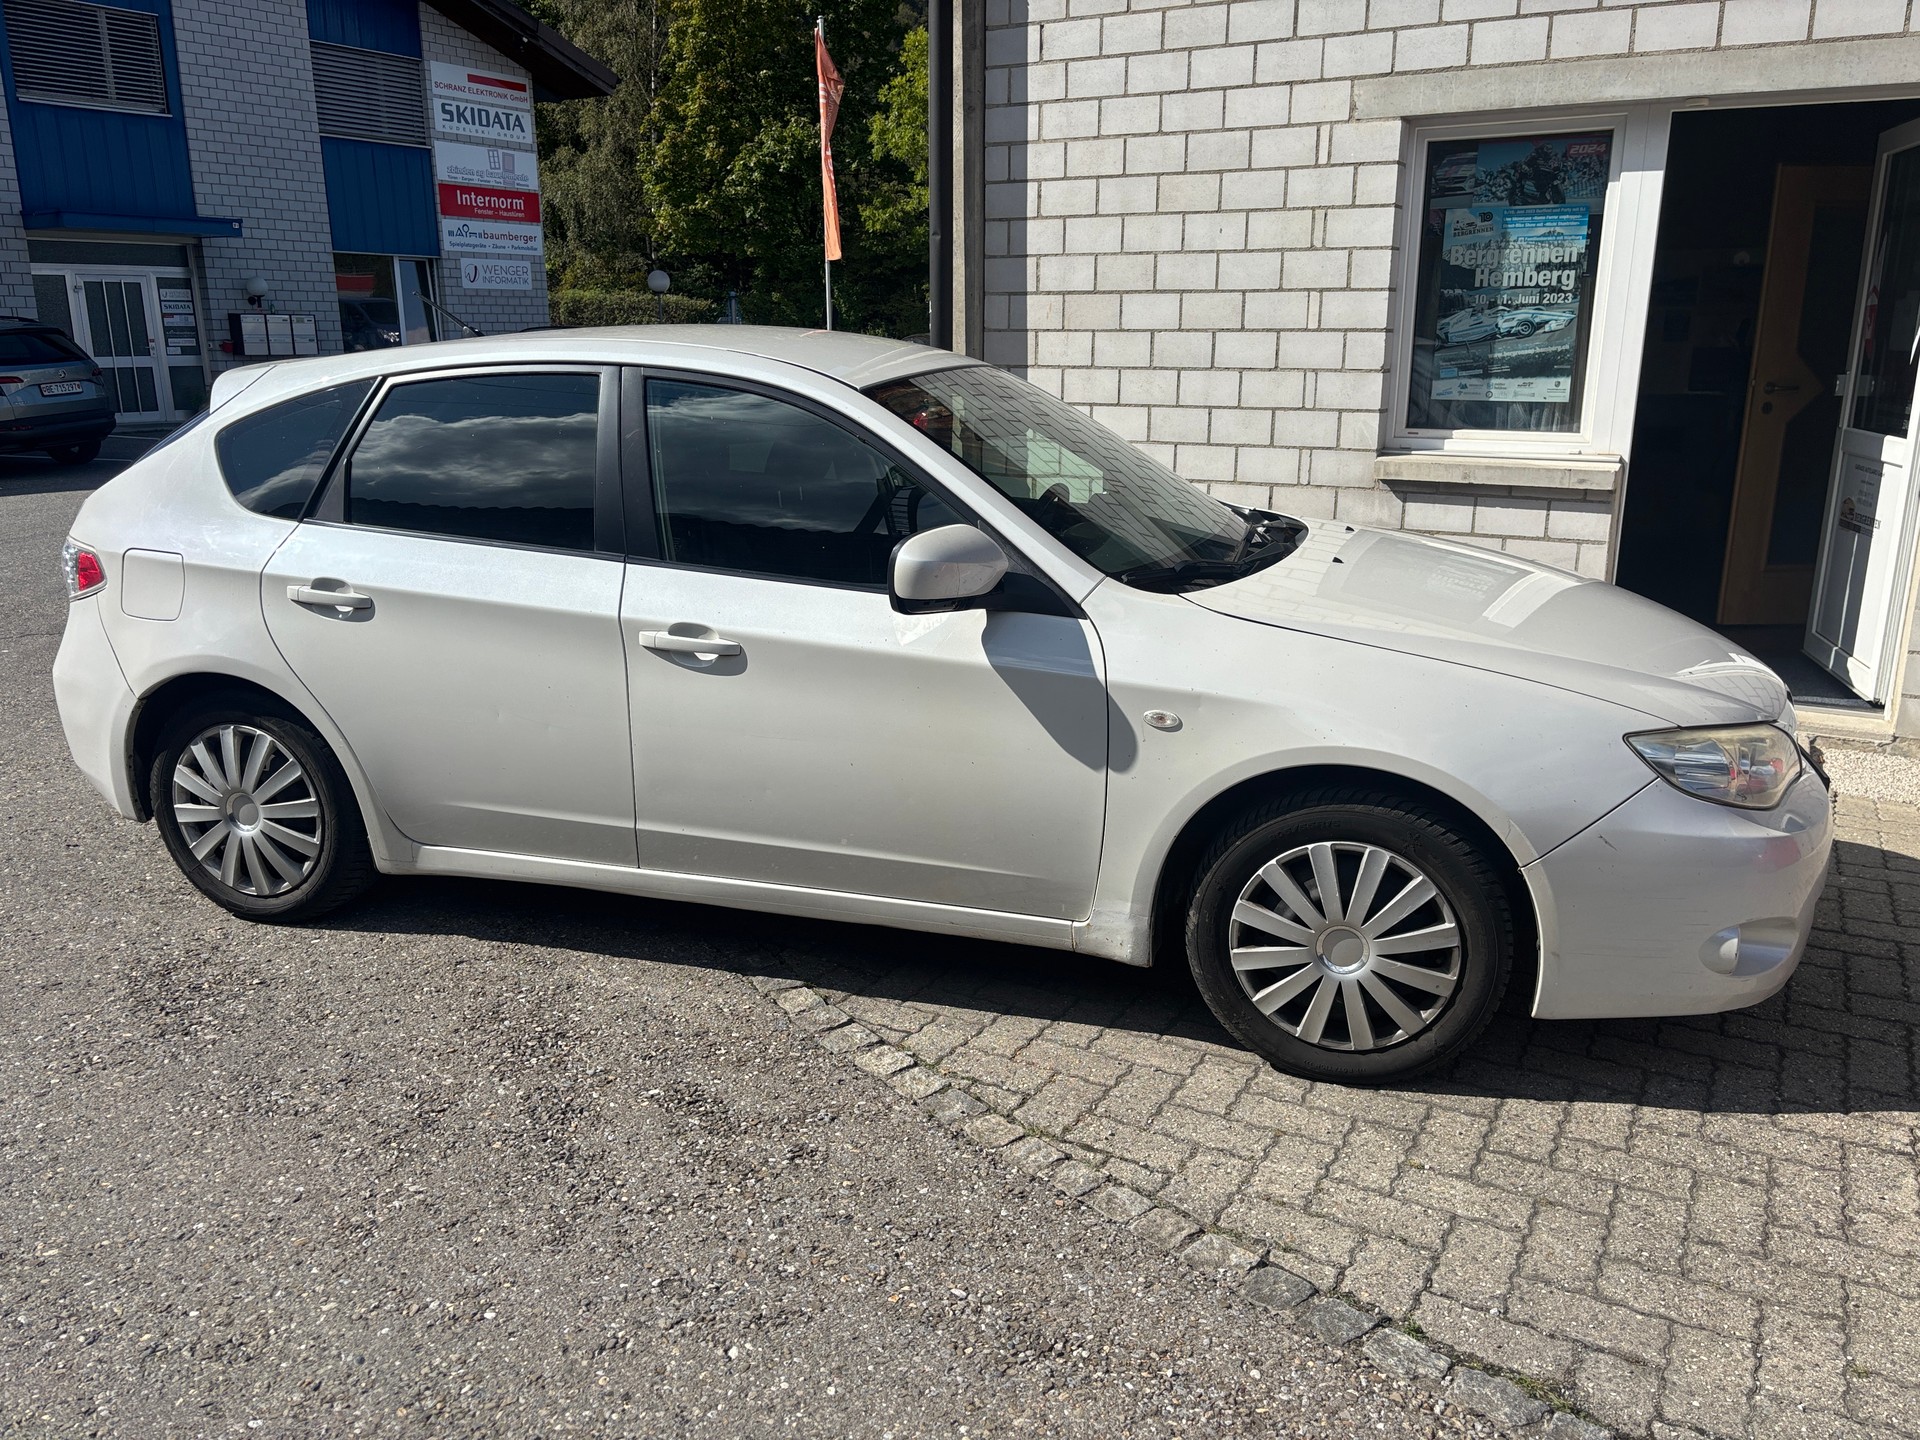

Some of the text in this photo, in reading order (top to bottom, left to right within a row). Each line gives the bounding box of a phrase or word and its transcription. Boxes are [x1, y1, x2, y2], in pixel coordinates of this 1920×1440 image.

[434, 81, 528, 103] SCHRANZ ELEKTRONIK GmbH
[440, 102, 525, 133] SKIDATA
[442, 124, 526, 140] KUDELSKI GROUP
[1568, 143, 1606, 154] 2024
[456, 189, 524, 210] Internorm
[474, 207, 494, 216] Fenster
[498, 210, 525, 218] Haustüren
[449, 241, 487, 249] Spielplatzgeräte
[1450, 245, 1578, 268] Bergrennen
[481, 264, 529, 276] WENGER
[482, 276, 529, 285] INFORMATIK
[1474, 267, 1576, 290] Hemberg
[1514, 293, 1540, 304] Juni
[1542, 292, 1573, 304] 2023
